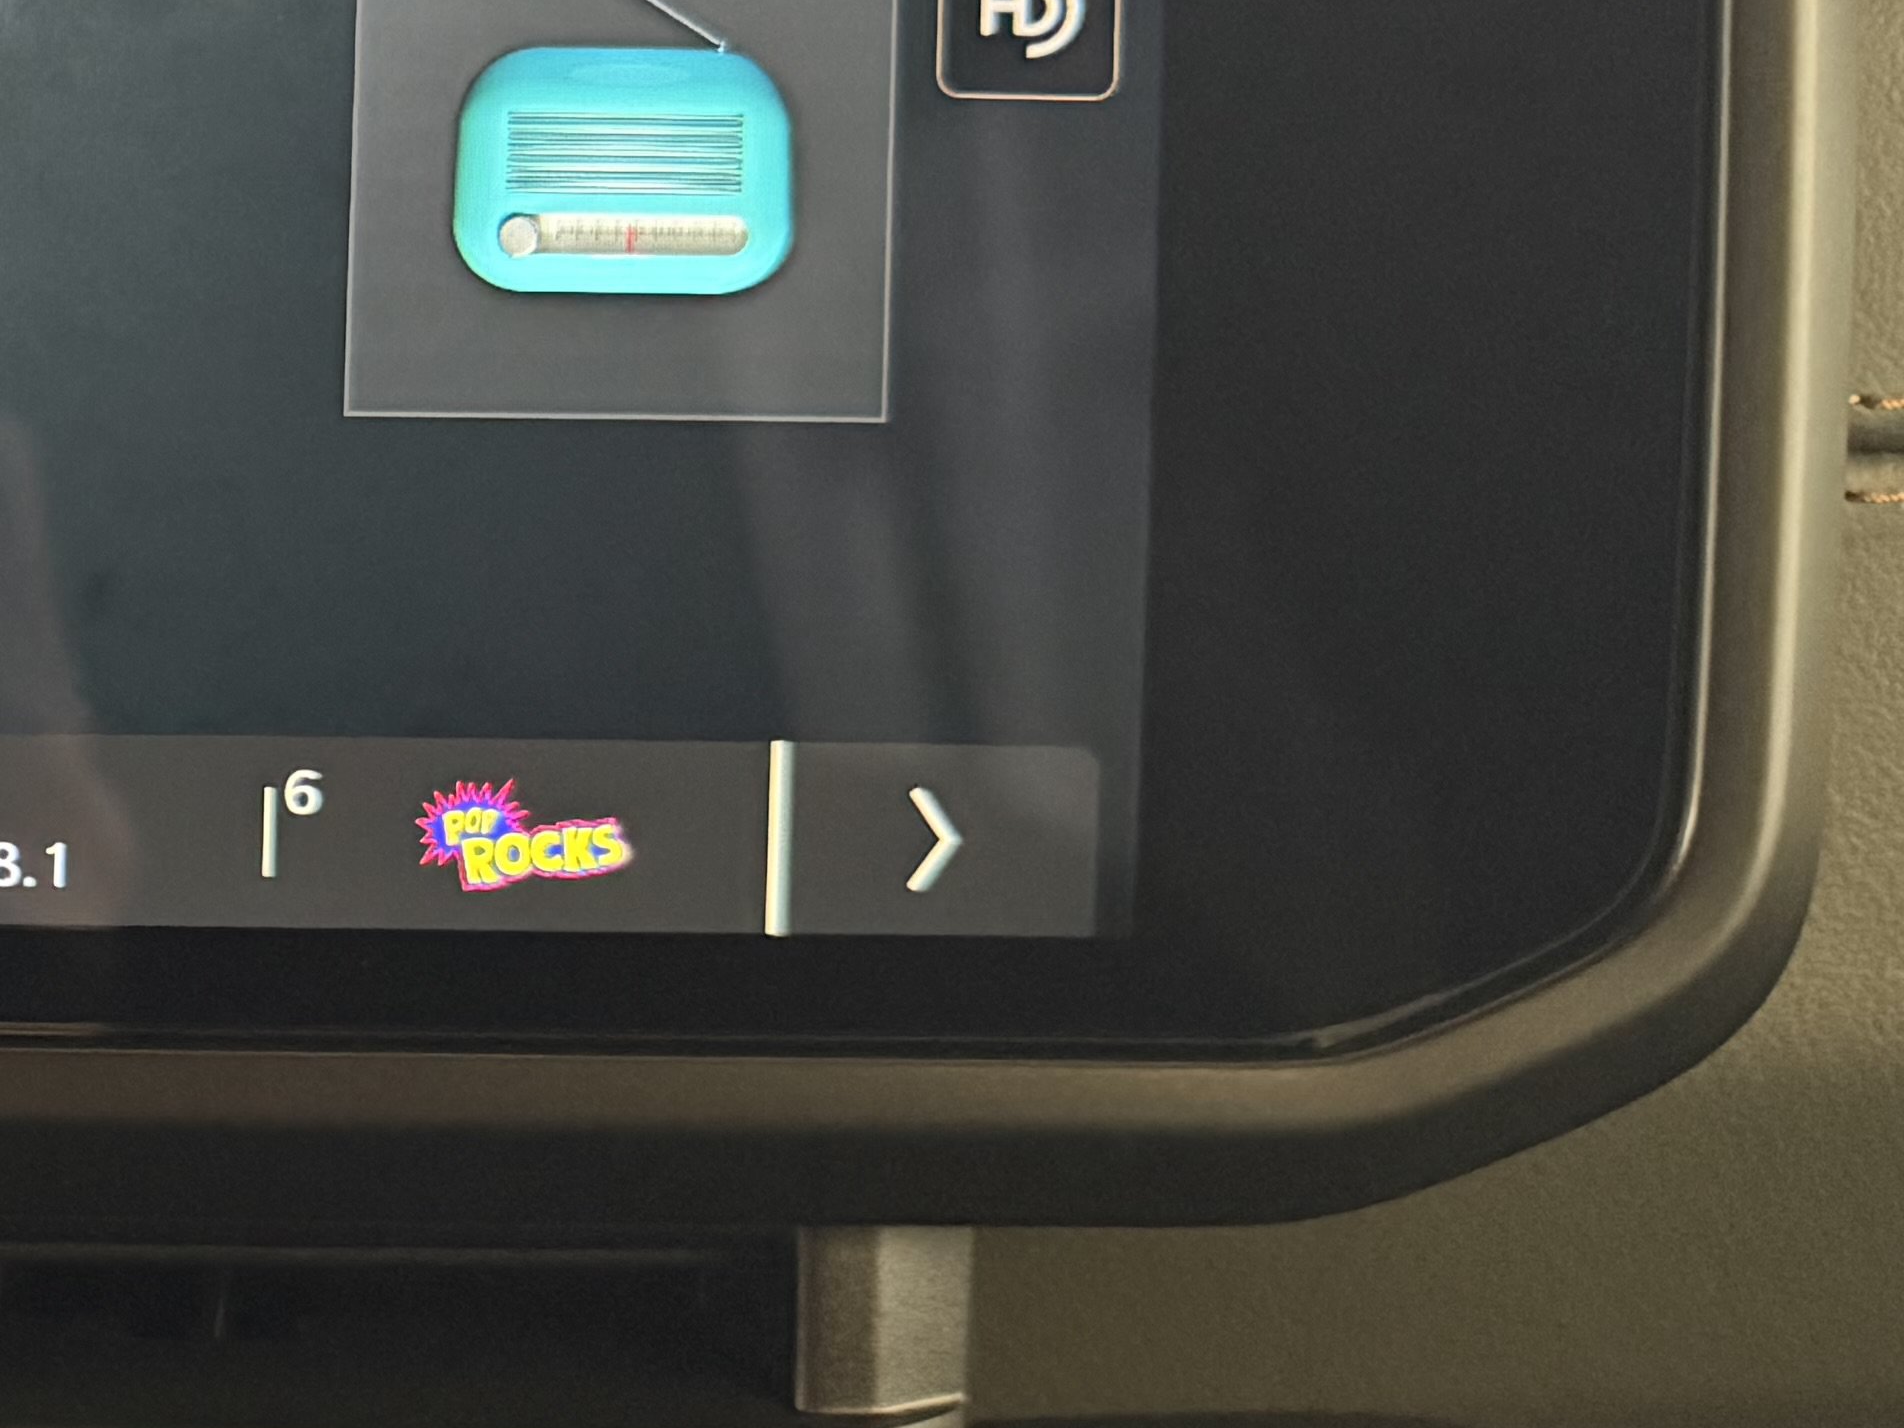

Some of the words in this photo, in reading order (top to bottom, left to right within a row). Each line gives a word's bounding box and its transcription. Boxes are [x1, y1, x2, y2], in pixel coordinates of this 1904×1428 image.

[283, 768, 324, 816] 6
[442, 807, 500, 846] POP
[461, 824, 626, 884] ROCKS
